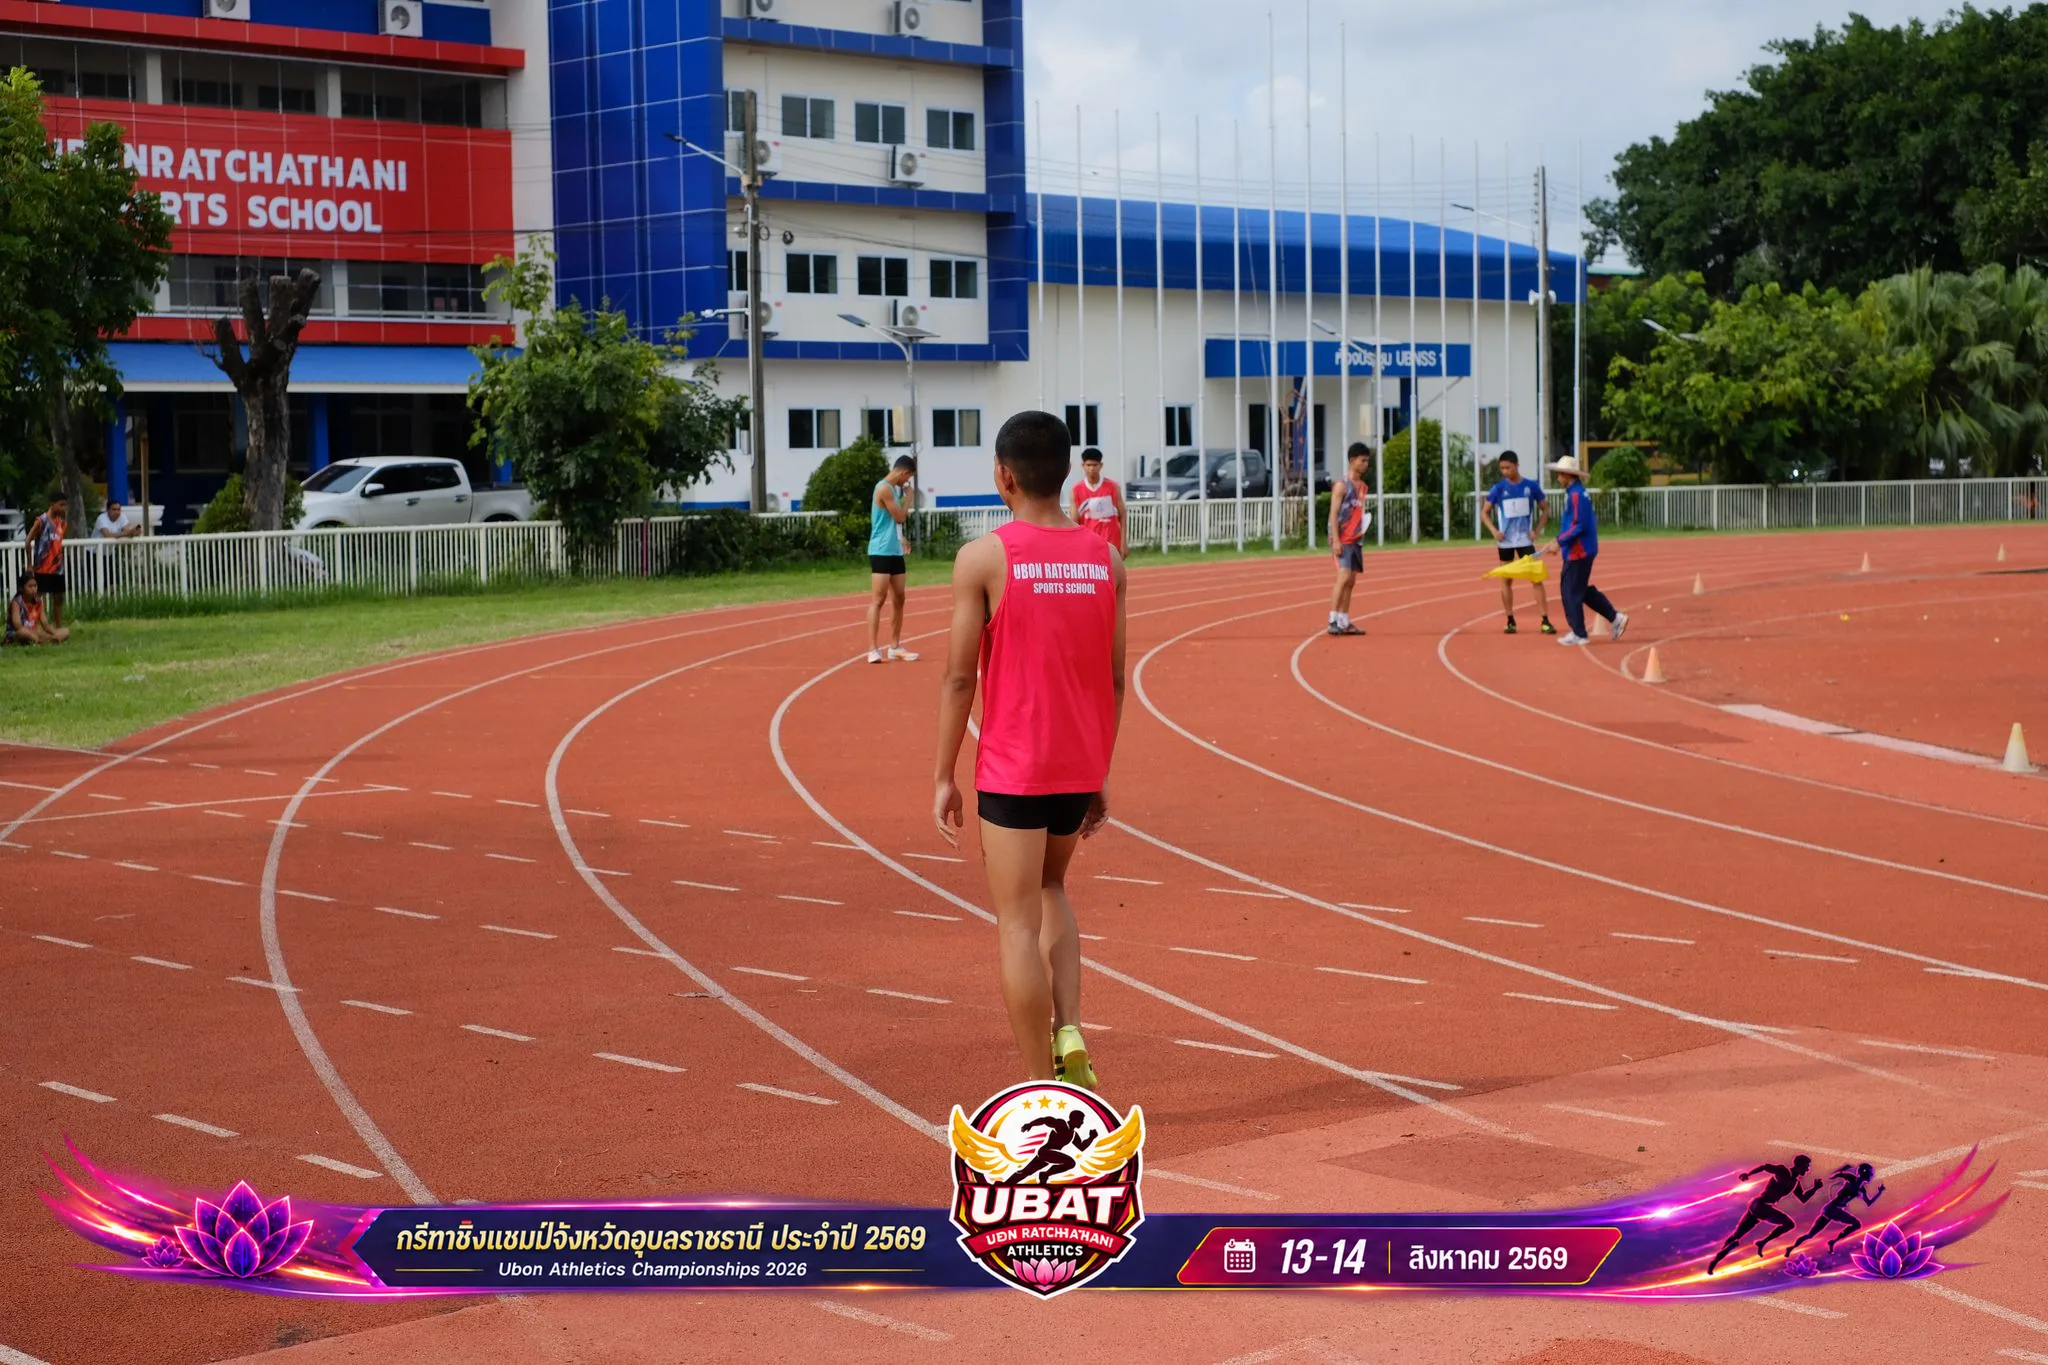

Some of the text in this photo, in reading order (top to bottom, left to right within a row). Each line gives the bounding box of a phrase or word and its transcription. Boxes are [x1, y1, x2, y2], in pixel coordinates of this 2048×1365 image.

[42, 137, 407, 192] NRATCHATHANI
[248, 196, 383, 233] SCHOOL
[1013, 563, 1042, 580] UBON
[1033, 582, 1096, 595] SPORTS SCHOOL
